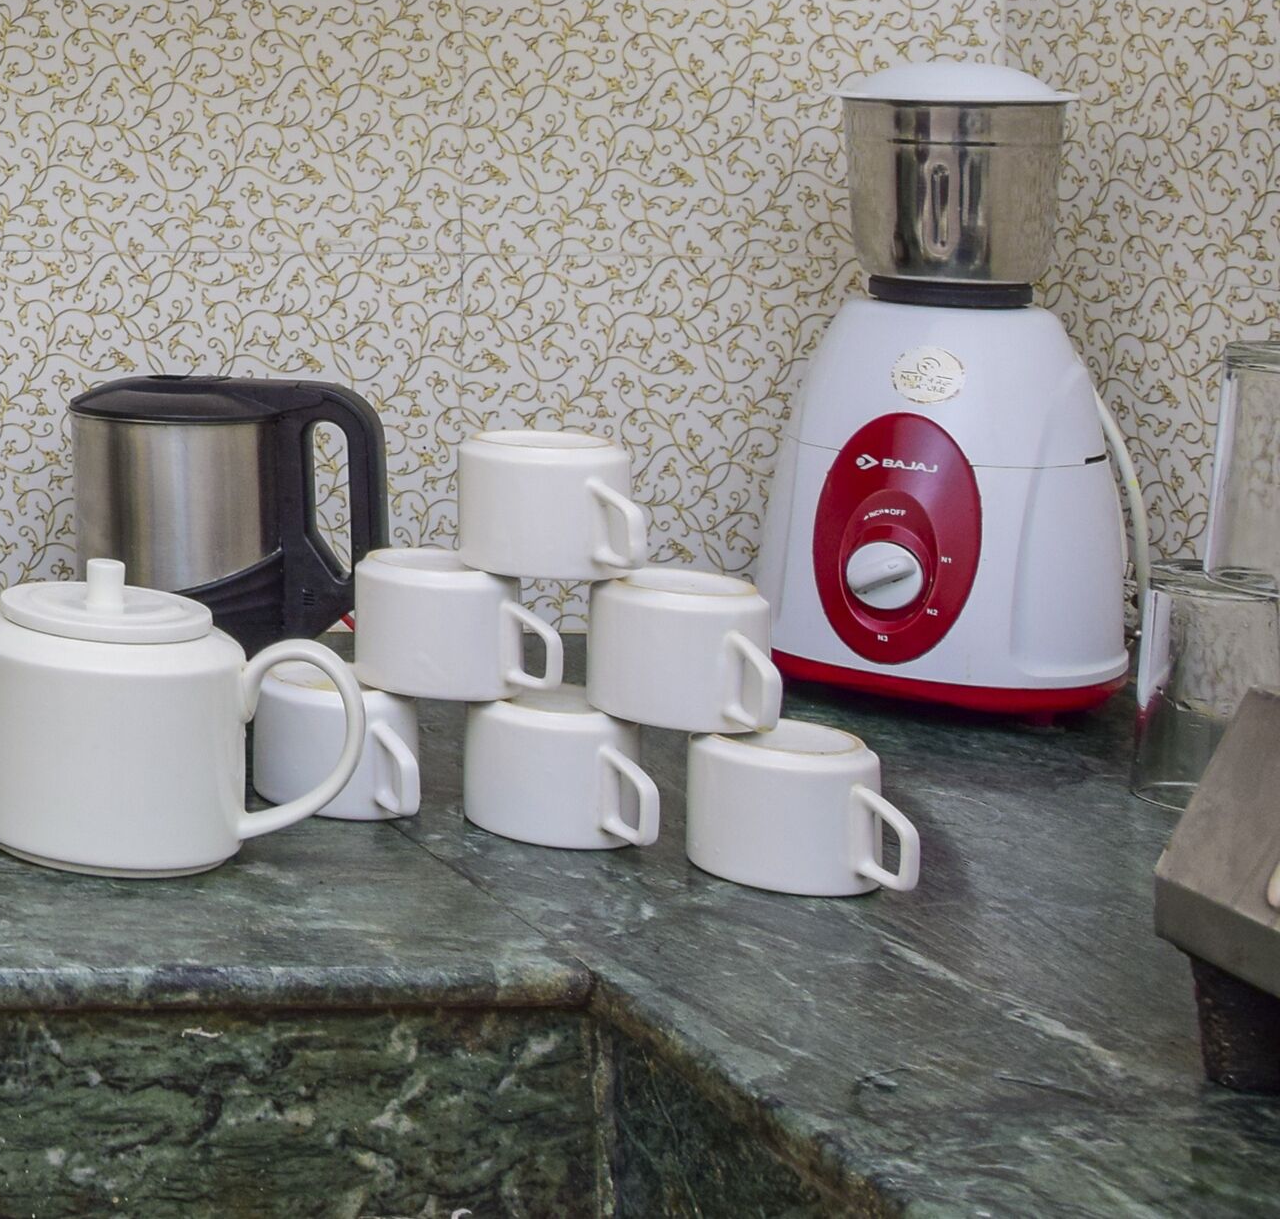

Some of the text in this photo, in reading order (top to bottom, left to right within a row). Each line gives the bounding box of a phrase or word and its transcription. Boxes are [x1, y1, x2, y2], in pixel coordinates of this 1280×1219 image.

[882, 458, 939, 474] BAJAJ
[890, 508, 907, 516] OFF
[940, 556, 952, 564] N1
[926, 607, 939, 617] N2
